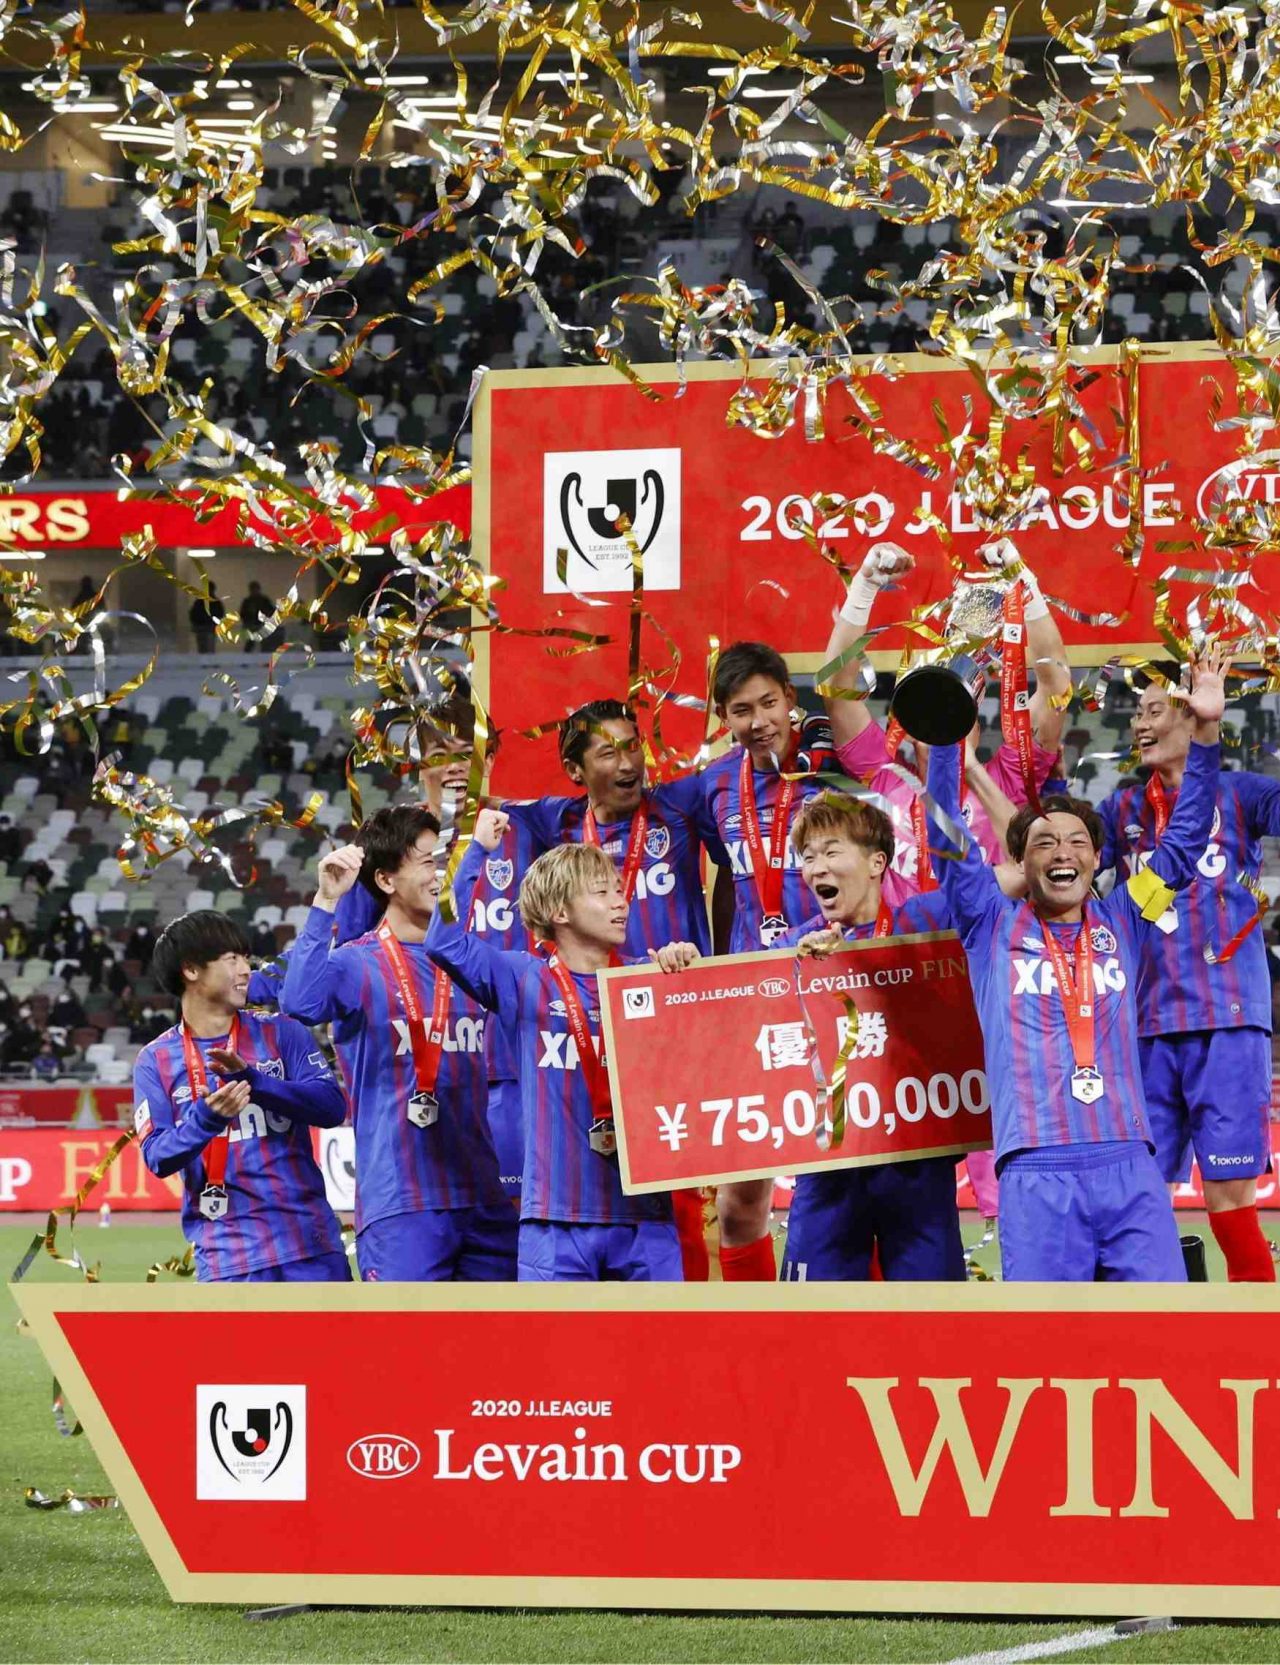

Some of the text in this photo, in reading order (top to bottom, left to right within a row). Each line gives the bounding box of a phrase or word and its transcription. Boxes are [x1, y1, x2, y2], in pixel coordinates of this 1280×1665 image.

[740, 491, 895, 541] 2020
[665, 956, 967, 1006] 2020 J.LEAGUE YBC Levain CUP FIN
[568, 1001, 582, 1034] Levain
[1216, 1157, 1242, 1166] TOKYO
[471, 1400, 612, 1417] 2020 J.LEAGUE
[357, 1427, 742, 1483] YBC Levain CUP
